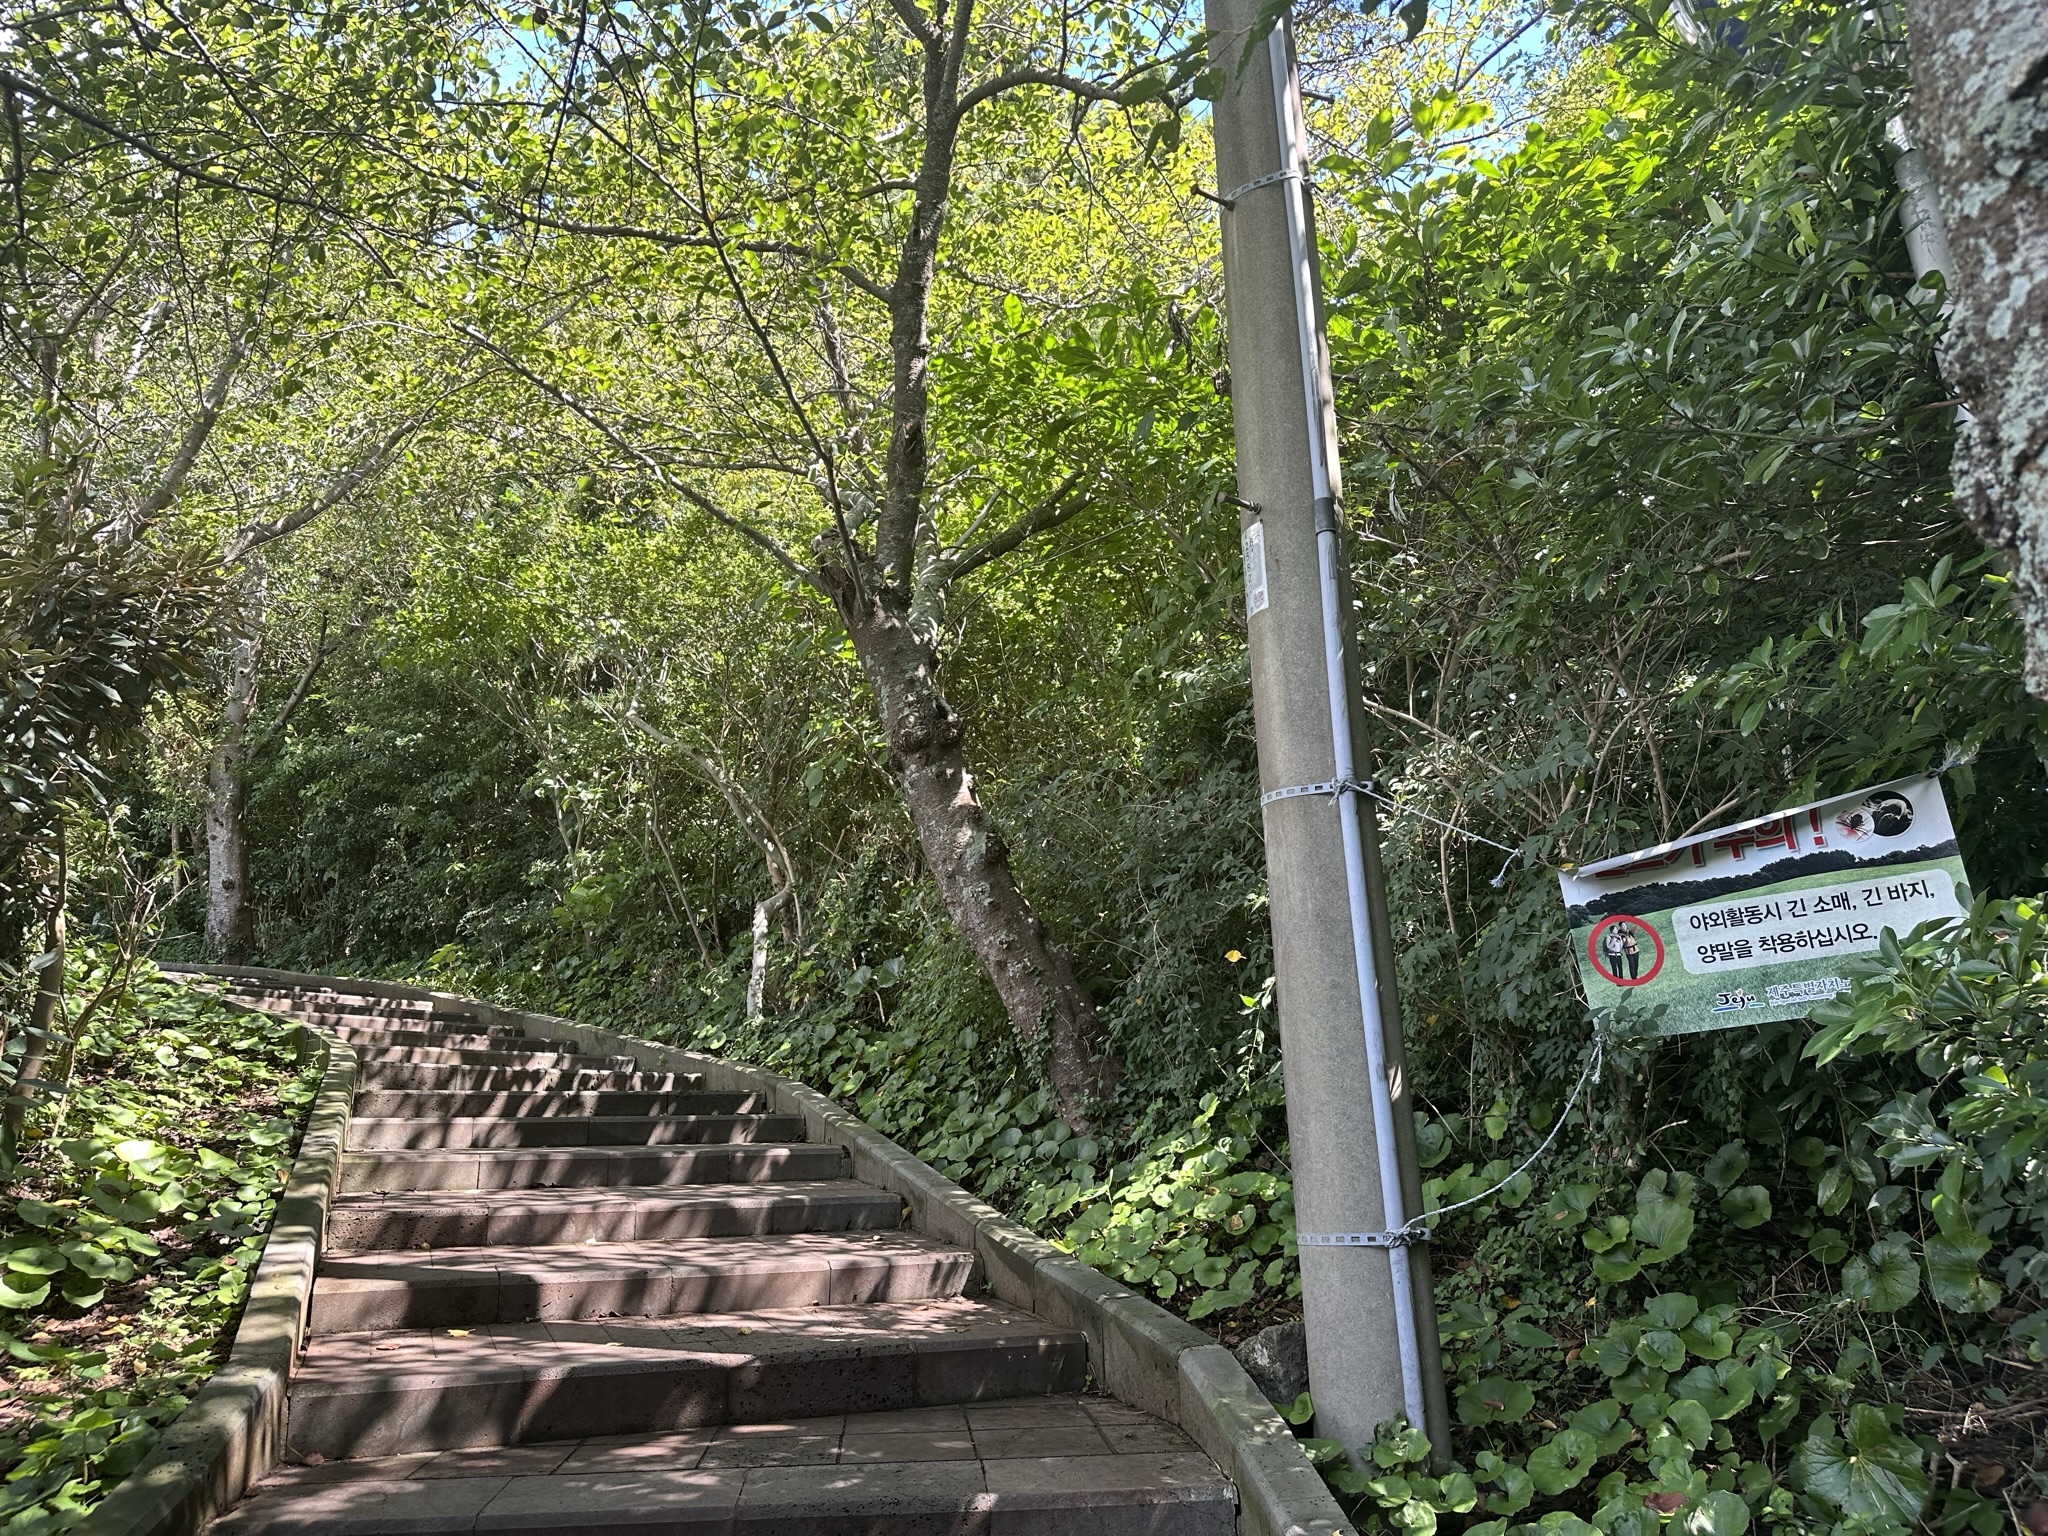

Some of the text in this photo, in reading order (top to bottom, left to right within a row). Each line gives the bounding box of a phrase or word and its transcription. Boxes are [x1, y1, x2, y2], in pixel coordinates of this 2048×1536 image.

[1689, 879, 1936, 932] 야외활동시 긴 소매, 긴 바지,
[1697, 922, 1878, 964] 양말을 착용하십시오.
[1717, 990, 1756, 1009] Jeju
